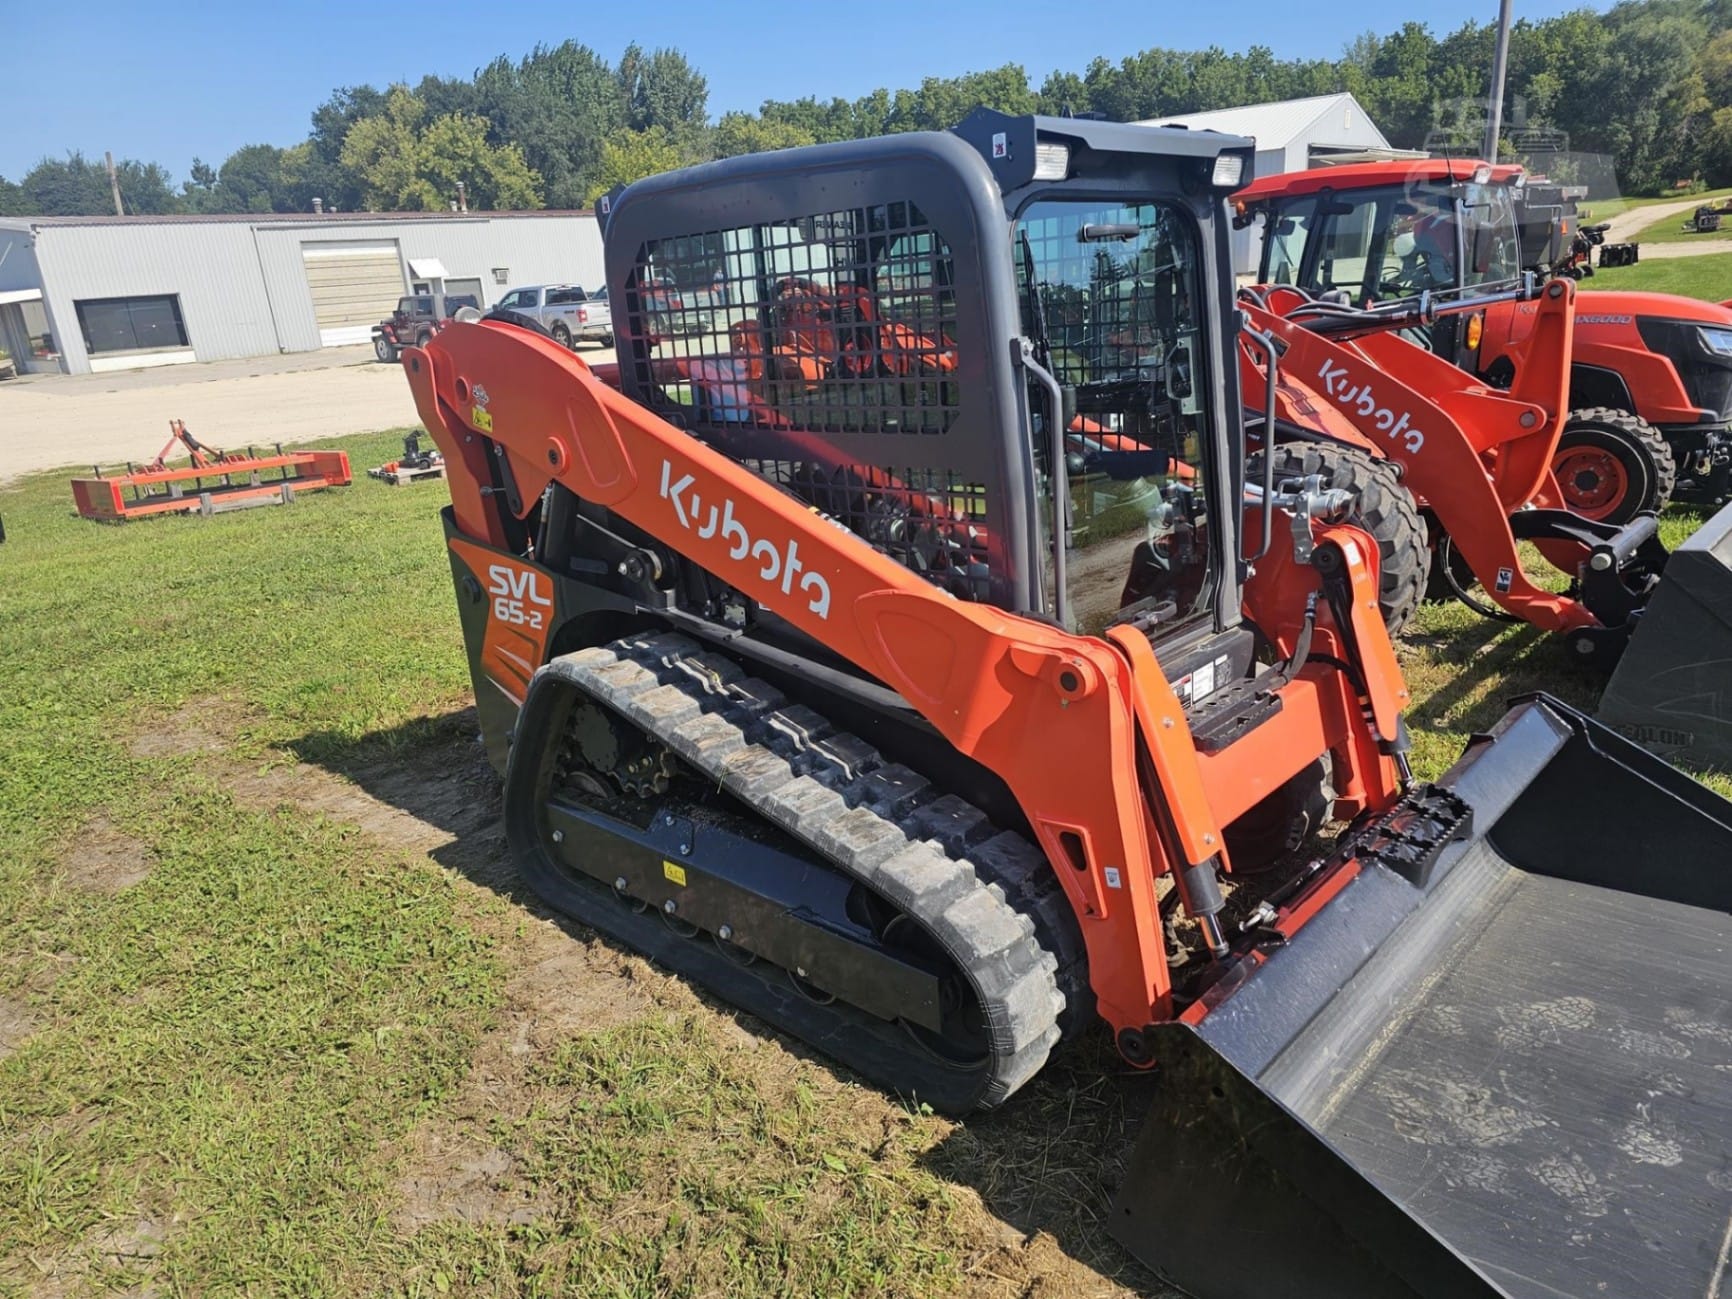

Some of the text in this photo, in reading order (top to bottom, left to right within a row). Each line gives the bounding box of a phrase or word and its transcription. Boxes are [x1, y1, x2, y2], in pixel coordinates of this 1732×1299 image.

[1317, 358, 1425, 454] Kubota
[659, 459, 831, 620] Kubota
[489, 564, 551, 606] SVL
[494, 597, 542, 630] 65-2
